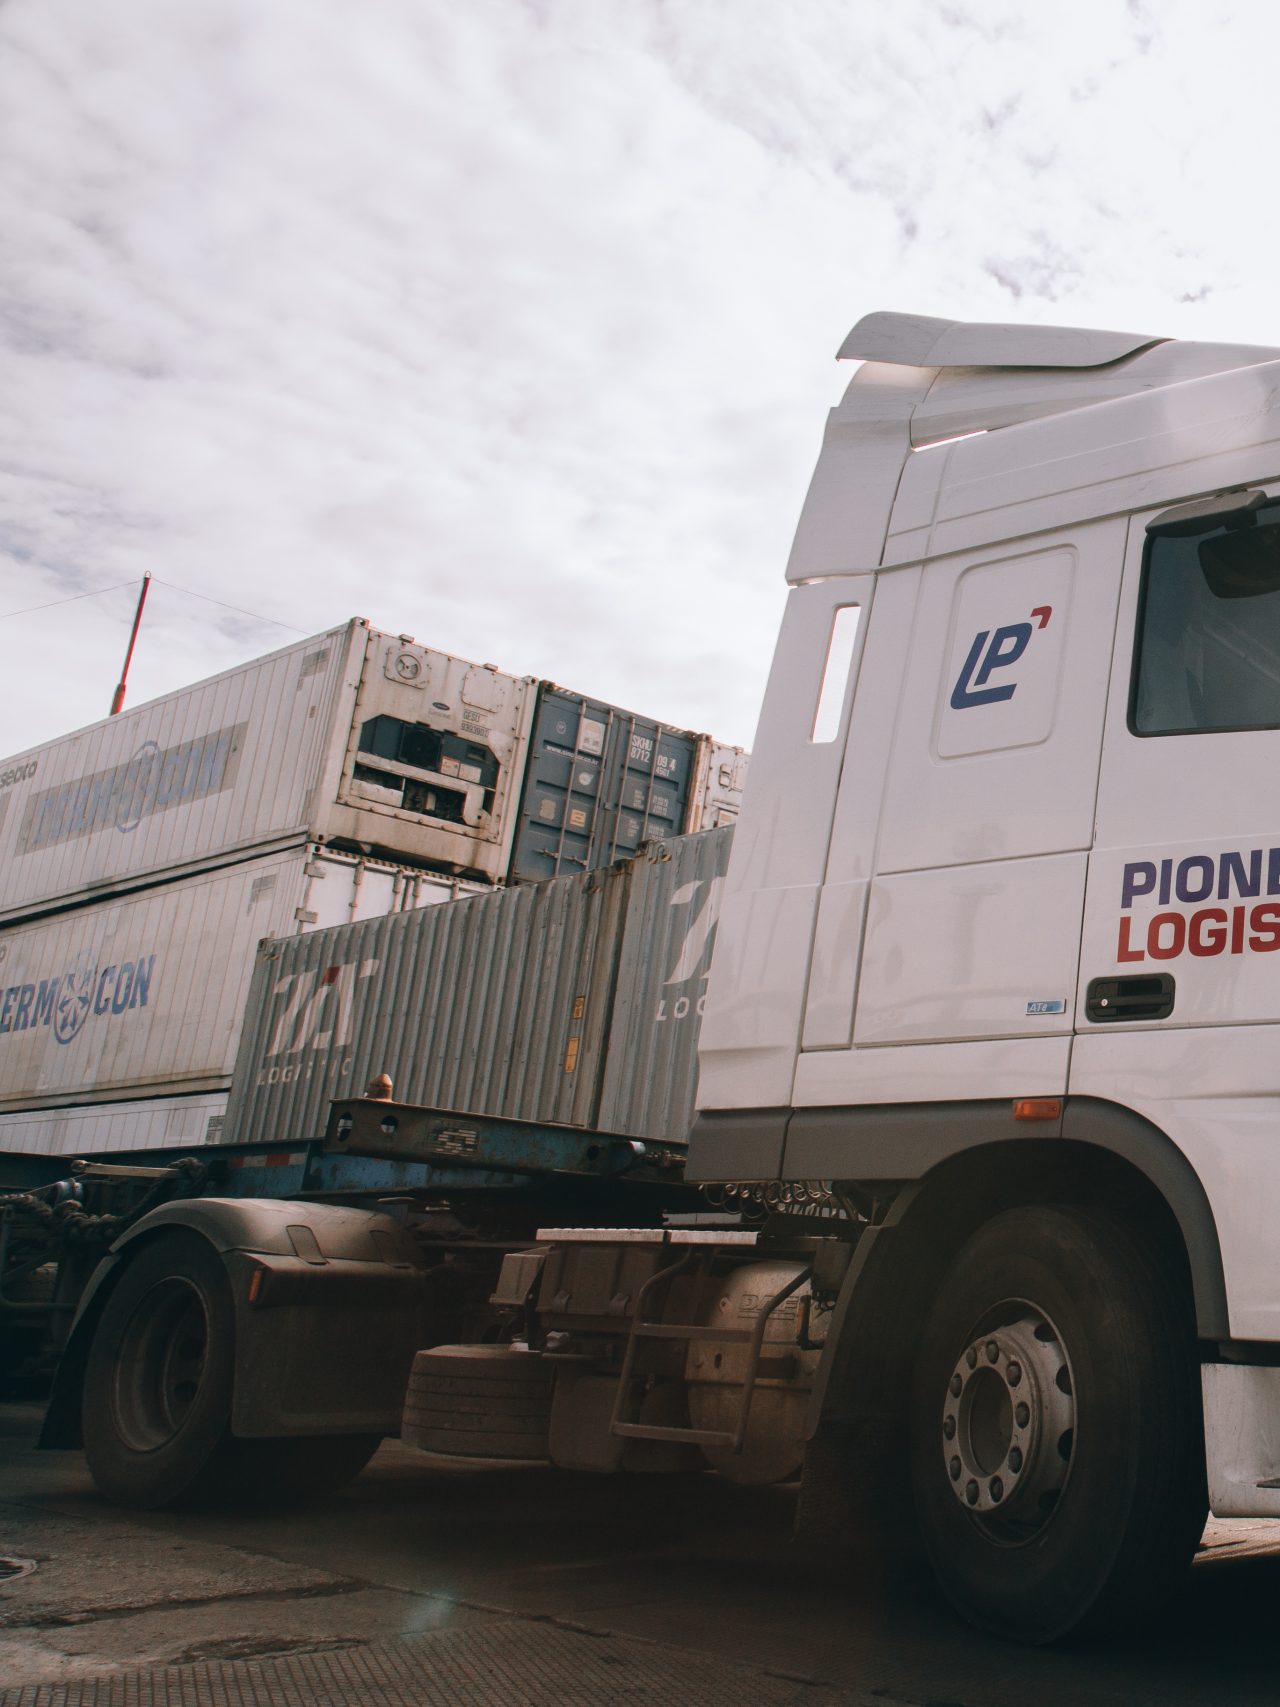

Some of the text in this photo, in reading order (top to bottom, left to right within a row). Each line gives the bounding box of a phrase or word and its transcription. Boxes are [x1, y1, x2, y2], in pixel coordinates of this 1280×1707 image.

[632, 734, 654, 751] SKHU
[630, 747, 651, 763] 8712
[0, 976, 60, 1034] ERM
